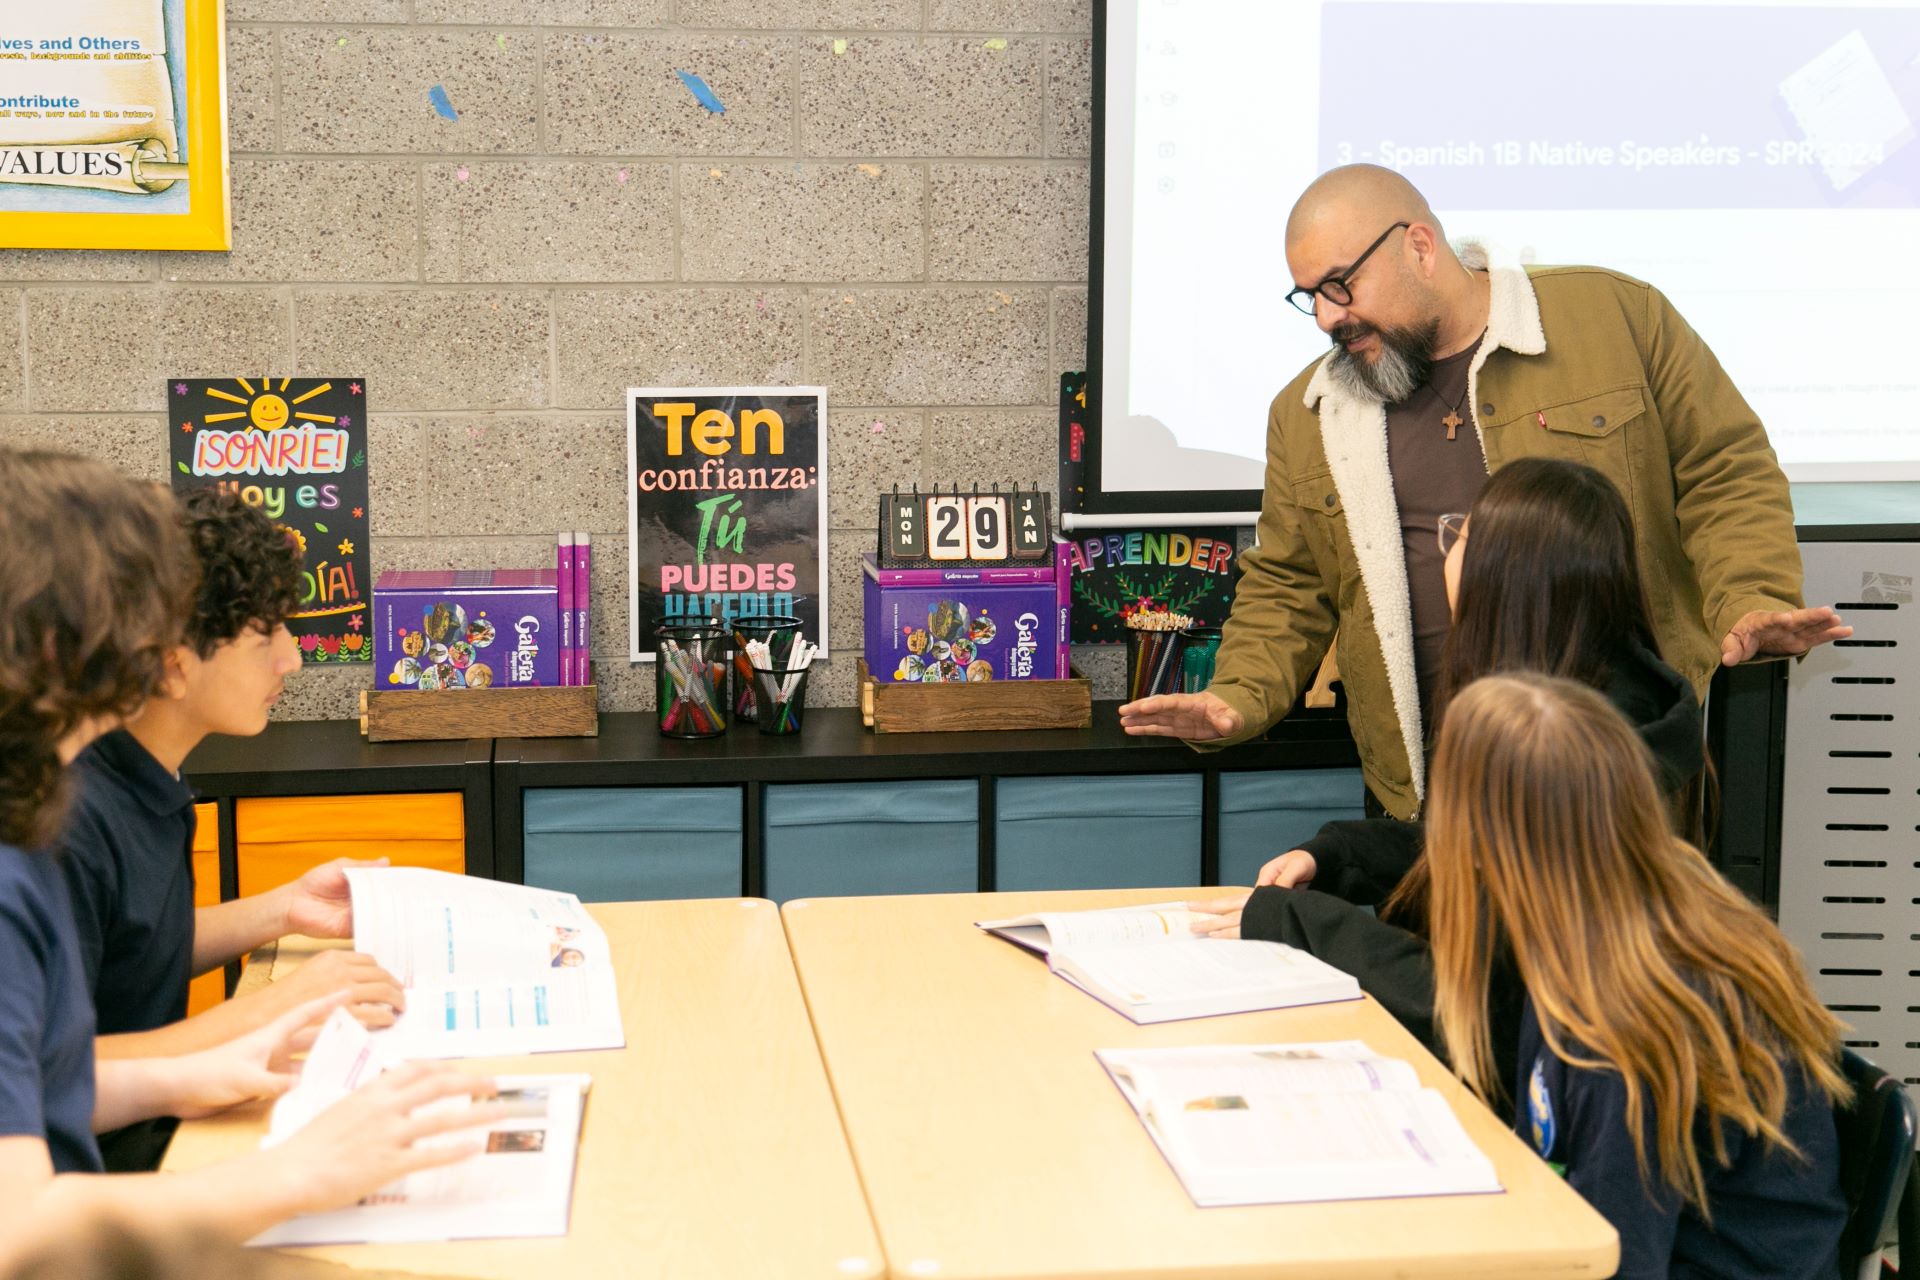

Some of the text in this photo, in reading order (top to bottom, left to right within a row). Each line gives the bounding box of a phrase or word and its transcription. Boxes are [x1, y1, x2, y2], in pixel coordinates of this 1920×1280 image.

[30, 52, 90, 61] backgrounds
[114, 52, 152, 60] abilities
[40, 37, 72, 50] and
[79, 37, 140, 50] Others
[15, 111, 41, 119] ways,
[68, 110, 86, 118] and
[90, 110, 100, 118] in
[103, 110, 119, 118] the
[122, 110, 154, 118] future
[1336, 140, 1354, 165] 3
[1379, 139, 1485, 173] Spanish
[1492, 140, 1522, 166] 1B
[1528, 140, 1614, 166] Native
[1619, 139, 1741, 172] Speakers
[1765, 140, 1815, 166] SPR
[653, 402, 785, 456] Ten
[196, 425, 346, 471] ¡SONRÍE!
[638, 458, 817, 491] confianza:
[296, 483, 341, 510] es
[695, 493, 747, 565] Tú
[1062, 558, 1067, 567] 1
[1070, 531, 1233, 576] APRENDER
[660, 562, 797, 593] PUEDES
[514, 615, 540, 682] Galería
[1014, 612, 1040, 678] Galería
